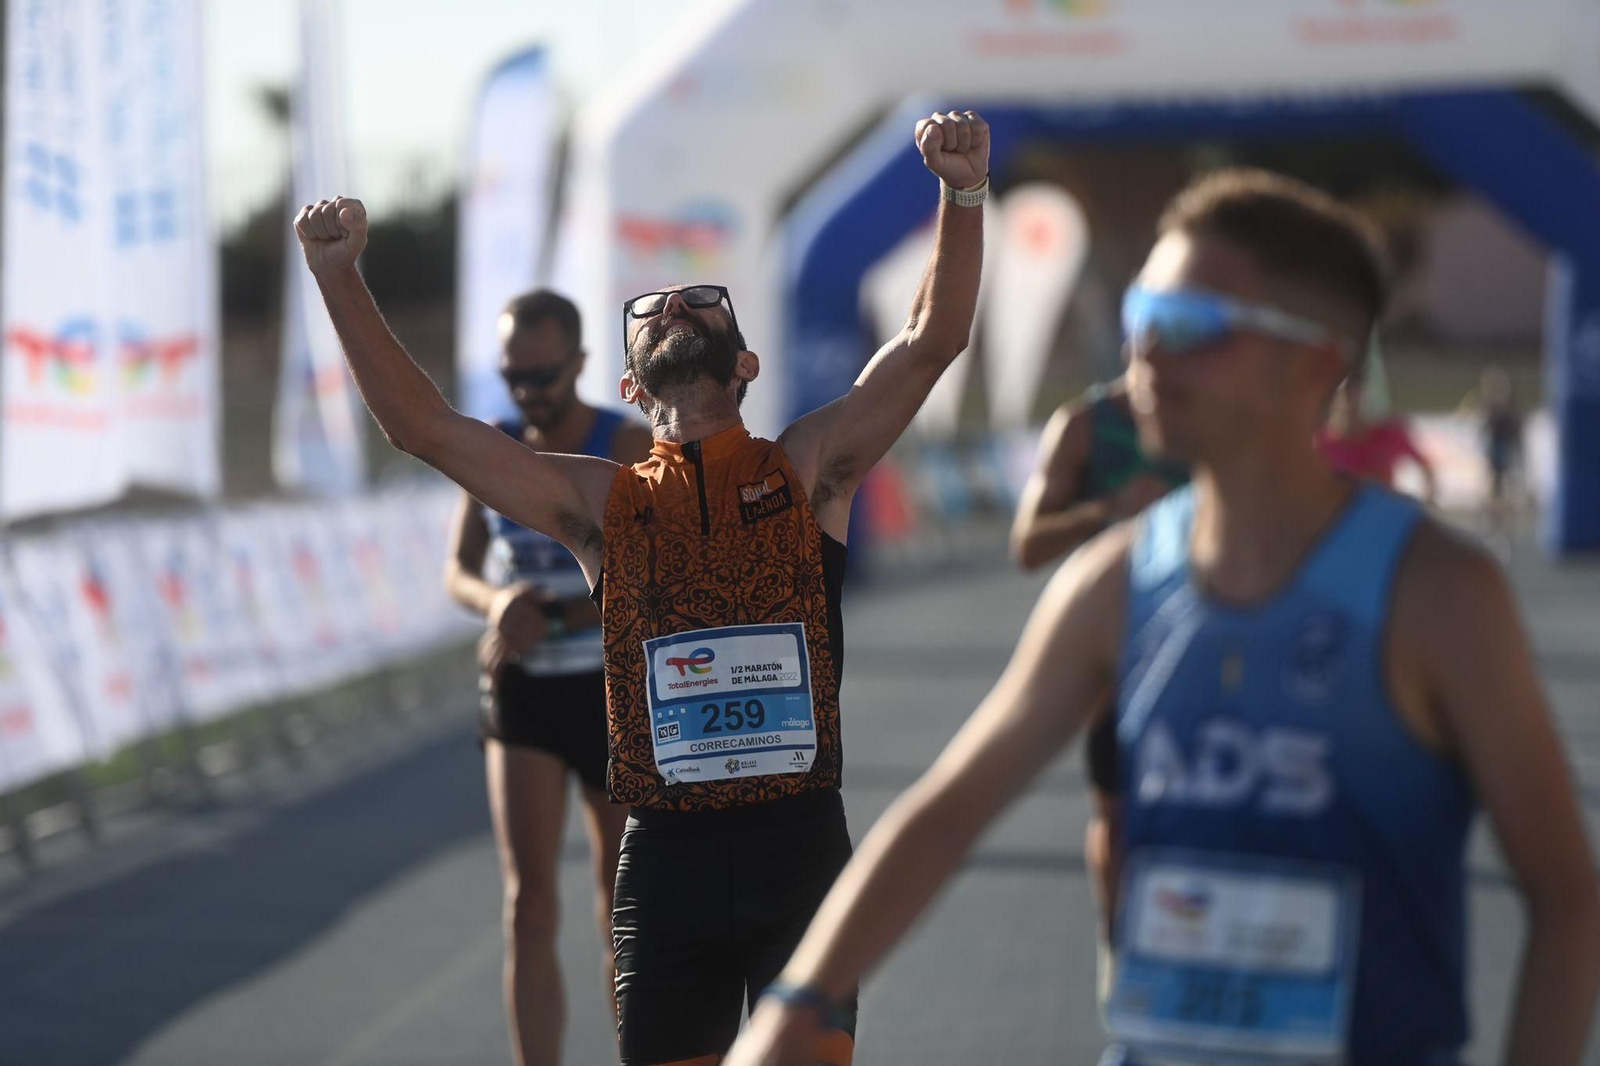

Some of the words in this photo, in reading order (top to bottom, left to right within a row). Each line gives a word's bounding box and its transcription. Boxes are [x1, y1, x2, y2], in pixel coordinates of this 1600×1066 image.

[730, 666, 744, 674] 1/2
[745, 662, 783, 672] MARATÓN
[667, 678, 719, 691] TotalEnergies
[731, 676, 743, 685] DE
[744, 673, 778, 683] MÁLAGA
[779, 672, 798, 681] 2022
[700, 699, 766, 734] 259
[689, 734, 782, 753] CORRECAMINOS
[1137, 719, 1332, 814] ADS
